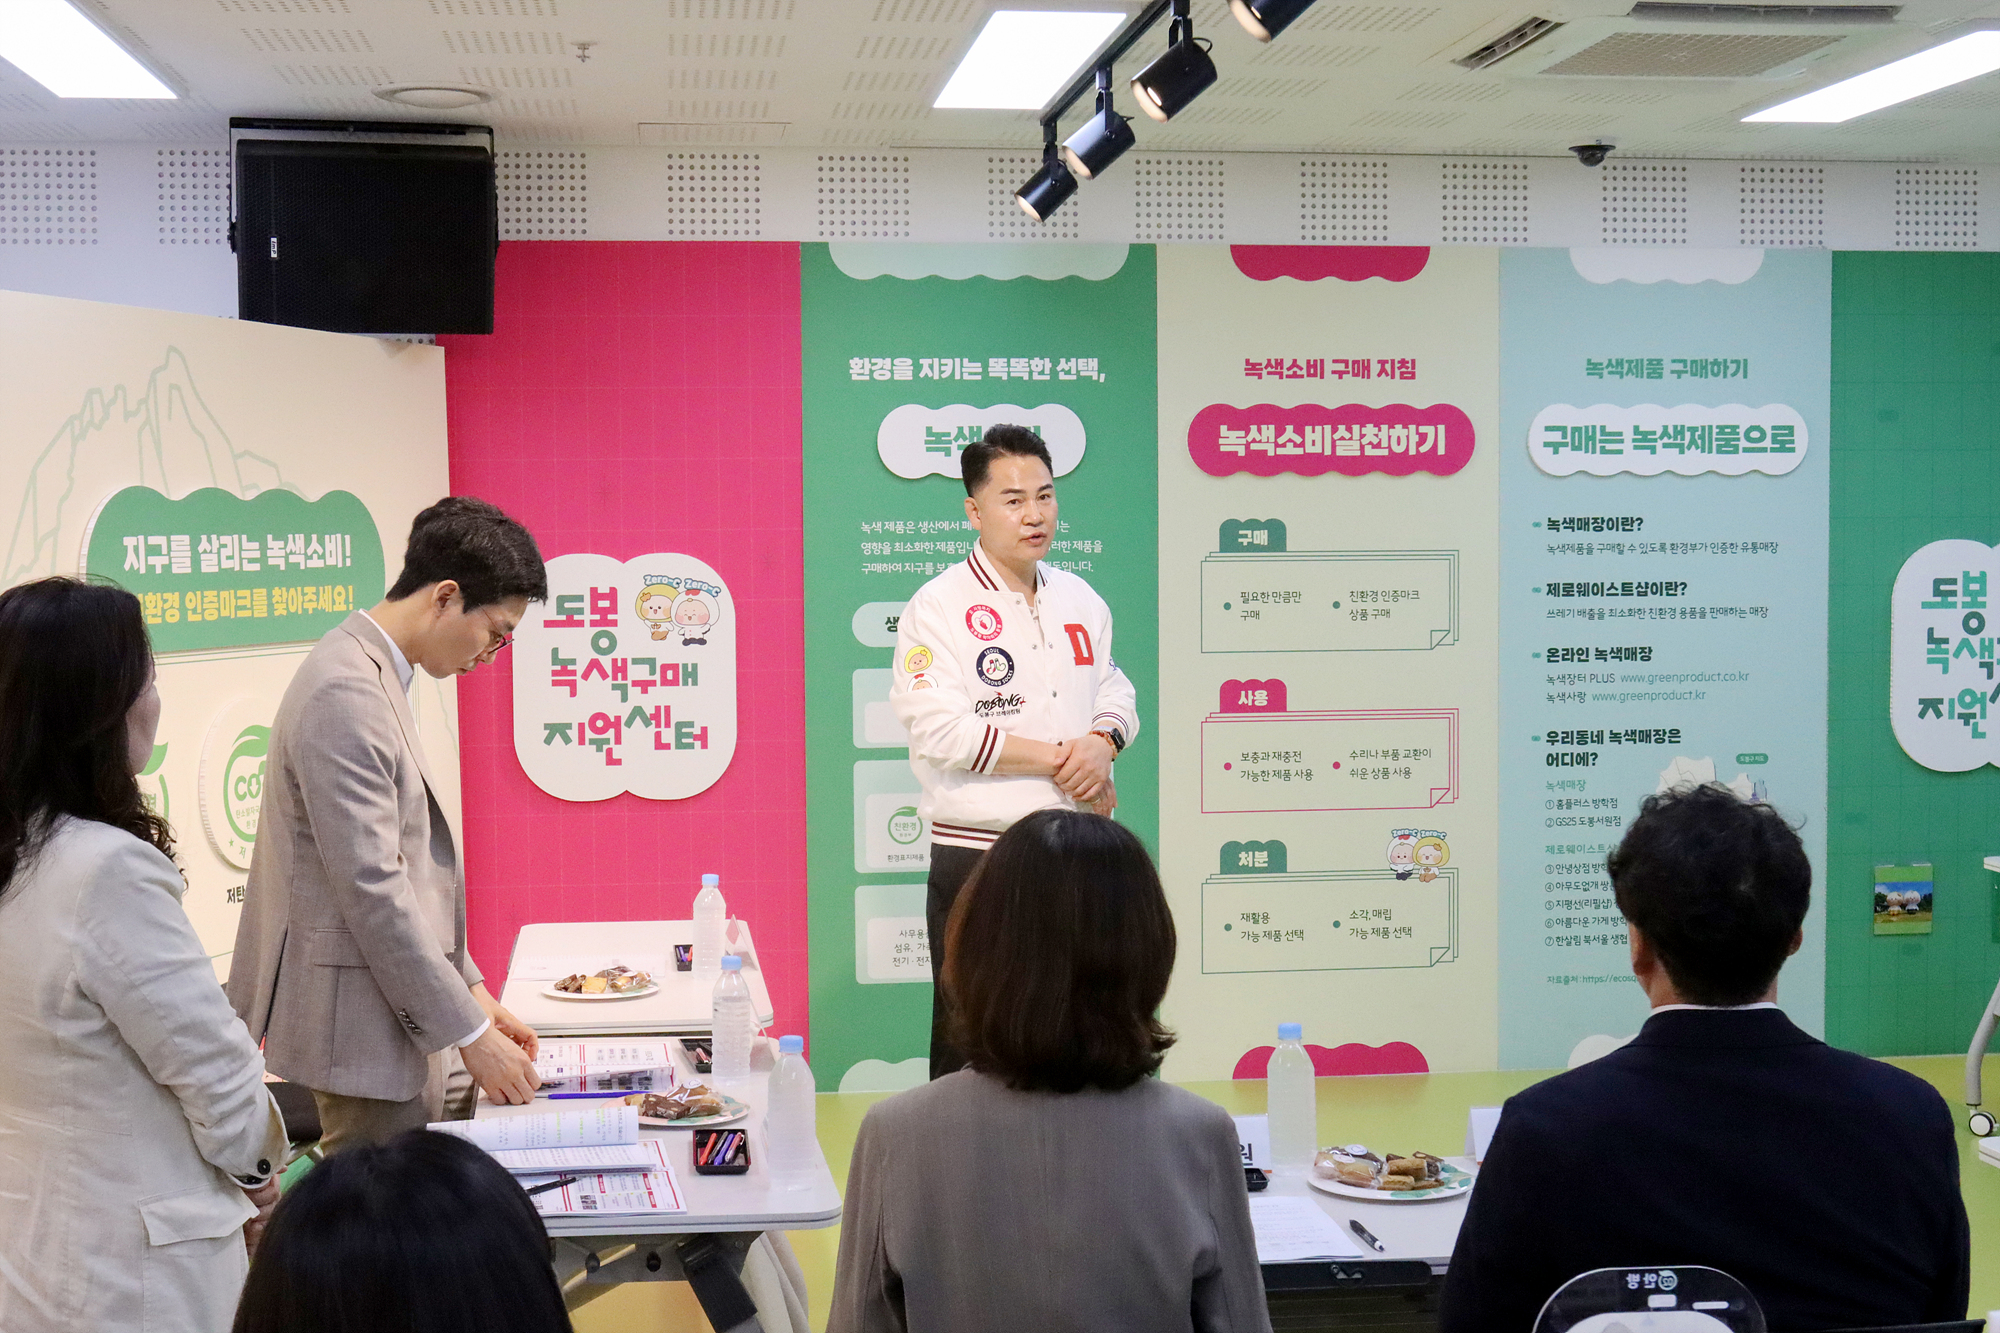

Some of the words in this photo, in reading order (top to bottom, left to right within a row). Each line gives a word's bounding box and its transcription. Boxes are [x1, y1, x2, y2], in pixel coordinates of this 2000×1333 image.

[849, 357, 914, 381] 환경을
[919, 357, 983, 381] 지키는
[988, 357, 1052, 381] 똑똑한
[1056, 357, 1106, 383] 선택,
[1243, 358, 1325, 380] 녹색소비
[1330, 358, 1371, 380] 구매
[1376, 358, 1417, 380] 지침
[1585, 358, 1664, 380] 녹색제품
[1669, 358, 1749, 380] 구매하기
[924, 425, 1042, 457] 녹색
[1218, 424, 1446, 457] 녹색소비실천하기
[1543, 424, 1625, 455] 구매는
[1631, 424, 1797, 455] 녹색제품으로
[861, 521, 882, 534] 녹색
[884, 521, 916, 534] 제품은
[917, 521, 960, 534] 생산에서
[961, 521, 975, 531] 폐
[1056, 520, 1070, 533] 는
[1547, 516, 1644, 533] 녹색매장이란?
[1238, 529, 1269, 547] 구매
[860, 542, 893, 555] 영향을
[893, 542, 934, 555] 최소화한
[1048, 541, 1072, 553] 러한
[1072, 540, 1103, 553] 제품을
[1546, 543, 1595, 555] 녹색제품을
[1597, 542, 1625, 555] 구매할
[1627, 543, 1637, 553] 수
[1638, 542, 1667, 554] 있도록
[1669, 542, 1708, 554] 환경부가
[1709, 542, 1739, 554] 인증한
[1741, 542, 1779, 554] 유통매장
[123, 535, 192, 575] 지구를
[197, 534, 261, 573] 살리는
[266, 533, 352, 571] 녹색소비!
[860, 563, 902, 575] 구매하여
[903, 562, 934, 575] 지구를
[644, 575, 681, 588] Zero-C
[685, 579, 721, 597] Zero-C
[1546, 581, 1688, 598] 제로웨이스트샵이란?
[1240, 591, 1270, 604] 필요한
[1271, 590, 1302, 604] 만큼만
[1349, 590, 1379, 604] 친환경
[1381, 589, 1420, 603] 인증마크
[1921, 571, 1987, 636] 도봉
[137, 591, 181, 625] 환경
[185, 587, 269, 622] 인증마크를
[272, 585, 354, 617] 찾아주세요!
[1240, 610, 1260, 621] 구매
[1349, 609, 1368, 621] 상품
[1370, 608, 1391, 620] 구매
[1546, 608, 1575, 619] 쓰레기
[1577, 608, 1606, 620] 배출을
[1608, 608, 1646, 620] 최소화한
[1648, 607, 1677, 619] 친환경
[1679, 607, 1707, 620] 용품을
[1709, 606, 1748, 619] 판매하는
[1749, 606, 1769, 619] 매장
[543, 586, 619, 656] 도봉
[1063, 623, 1095, 667] D
[1546, 647, 1590, 663] 온라인
[1594, 646, 1653, 662] 녹색매장
[1926, 627, 2000, 680] 녹색
[551, 647, 699, 703] 녹색구매
[1546, 673, 1586, 685] 녹색장터
[1589, 673, 1616, 683] PLUS
[1620, 671, 1750, 685] www.greenproduct.co.kr
[1238, 690, 1269, 706] 사용
[1546, 691, 1587, 704] 녹색사랑
[1591, 690, 1706, 704] www.greenproduct.kr
[1918, 683, 2000, 739] 지원
[543, 705, 709, 766] 지원센터
[1546, 730, 1604, 746] 우리동네
[1608, 728, 1682, 745] 녹색매장은
[1240, 751, 1270, 763] 보충과
[1271, 750, 1302, 763] 재충전
[1349, 748, 1379, 761] 수리나
[1380, 749, 1400, 761] 부품
[1402, 748, 1432, 760] 교환이
[1546, 752, 1599, 768] 어디에?
[1240, 770, 1270, 782] 가능한
[1271, 769, 1292, 782] 제품
[1293, 769, 1314, 781] 사용
[1349, 768, 1369, 780] 쉬운
[1370, 768, 1391, 780] 상품
[1392, 767, 1412, 779] 사용
[1545, 780, 1586, 792] 녹색매장
[1556, 798, 1591, 810] 홈플러스
[1592, 798, 1618, 809] 방학점
[894, 822, 917, 831] 친환경
[1555, 817, 1577, 827] GS25
[1578, 816, 1621, 827] 도봉서원점
[1238, 851, 1269, 868] 처분
[1555, 863, 1590, 874] 안녕상점
[1240, 912, 1270, 924] 재활용
[1349, 909, 1371, 922] 소각,
[1372, 908, 1392, 921] 매립
[1555, 917, 1590, 929] 아름다운
[1591, 916, 1609, 926] 가게
[1240, 930, 1261, 943] 가능
[1262, 930, 1283, 942] 제품
[1284, 929, 1304, 941] 선택
[1349, 927, 1369, 940] 가능
[1370, 927, 1391, 940] 제품
[1392, 926, 1412, 939] 선택
[1555, 935, 1581, 947] 한살림
[1583, 934, 1609, 946] 북서울
[1610, 934, 1628, 946] 생협
